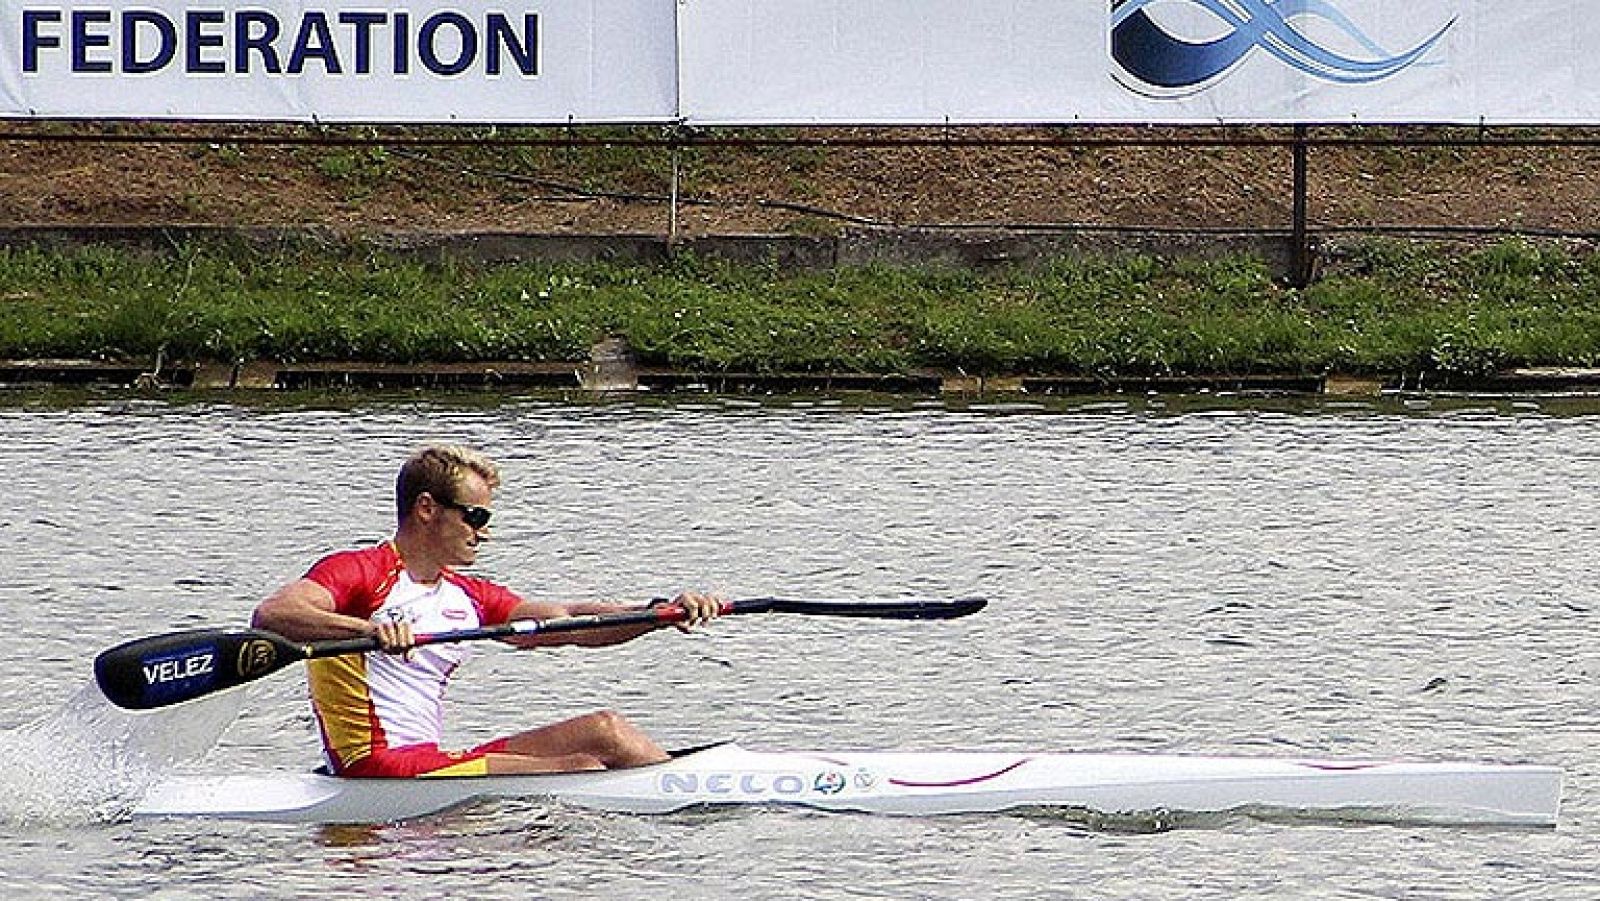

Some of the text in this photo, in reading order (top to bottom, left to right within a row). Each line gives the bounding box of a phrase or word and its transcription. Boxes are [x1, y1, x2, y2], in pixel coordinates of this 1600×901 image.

[21, 9, 540, 76] FEDERATION
[143, 654, 214, 684] VELEZ
[661, 773, 804, 794] NELO
